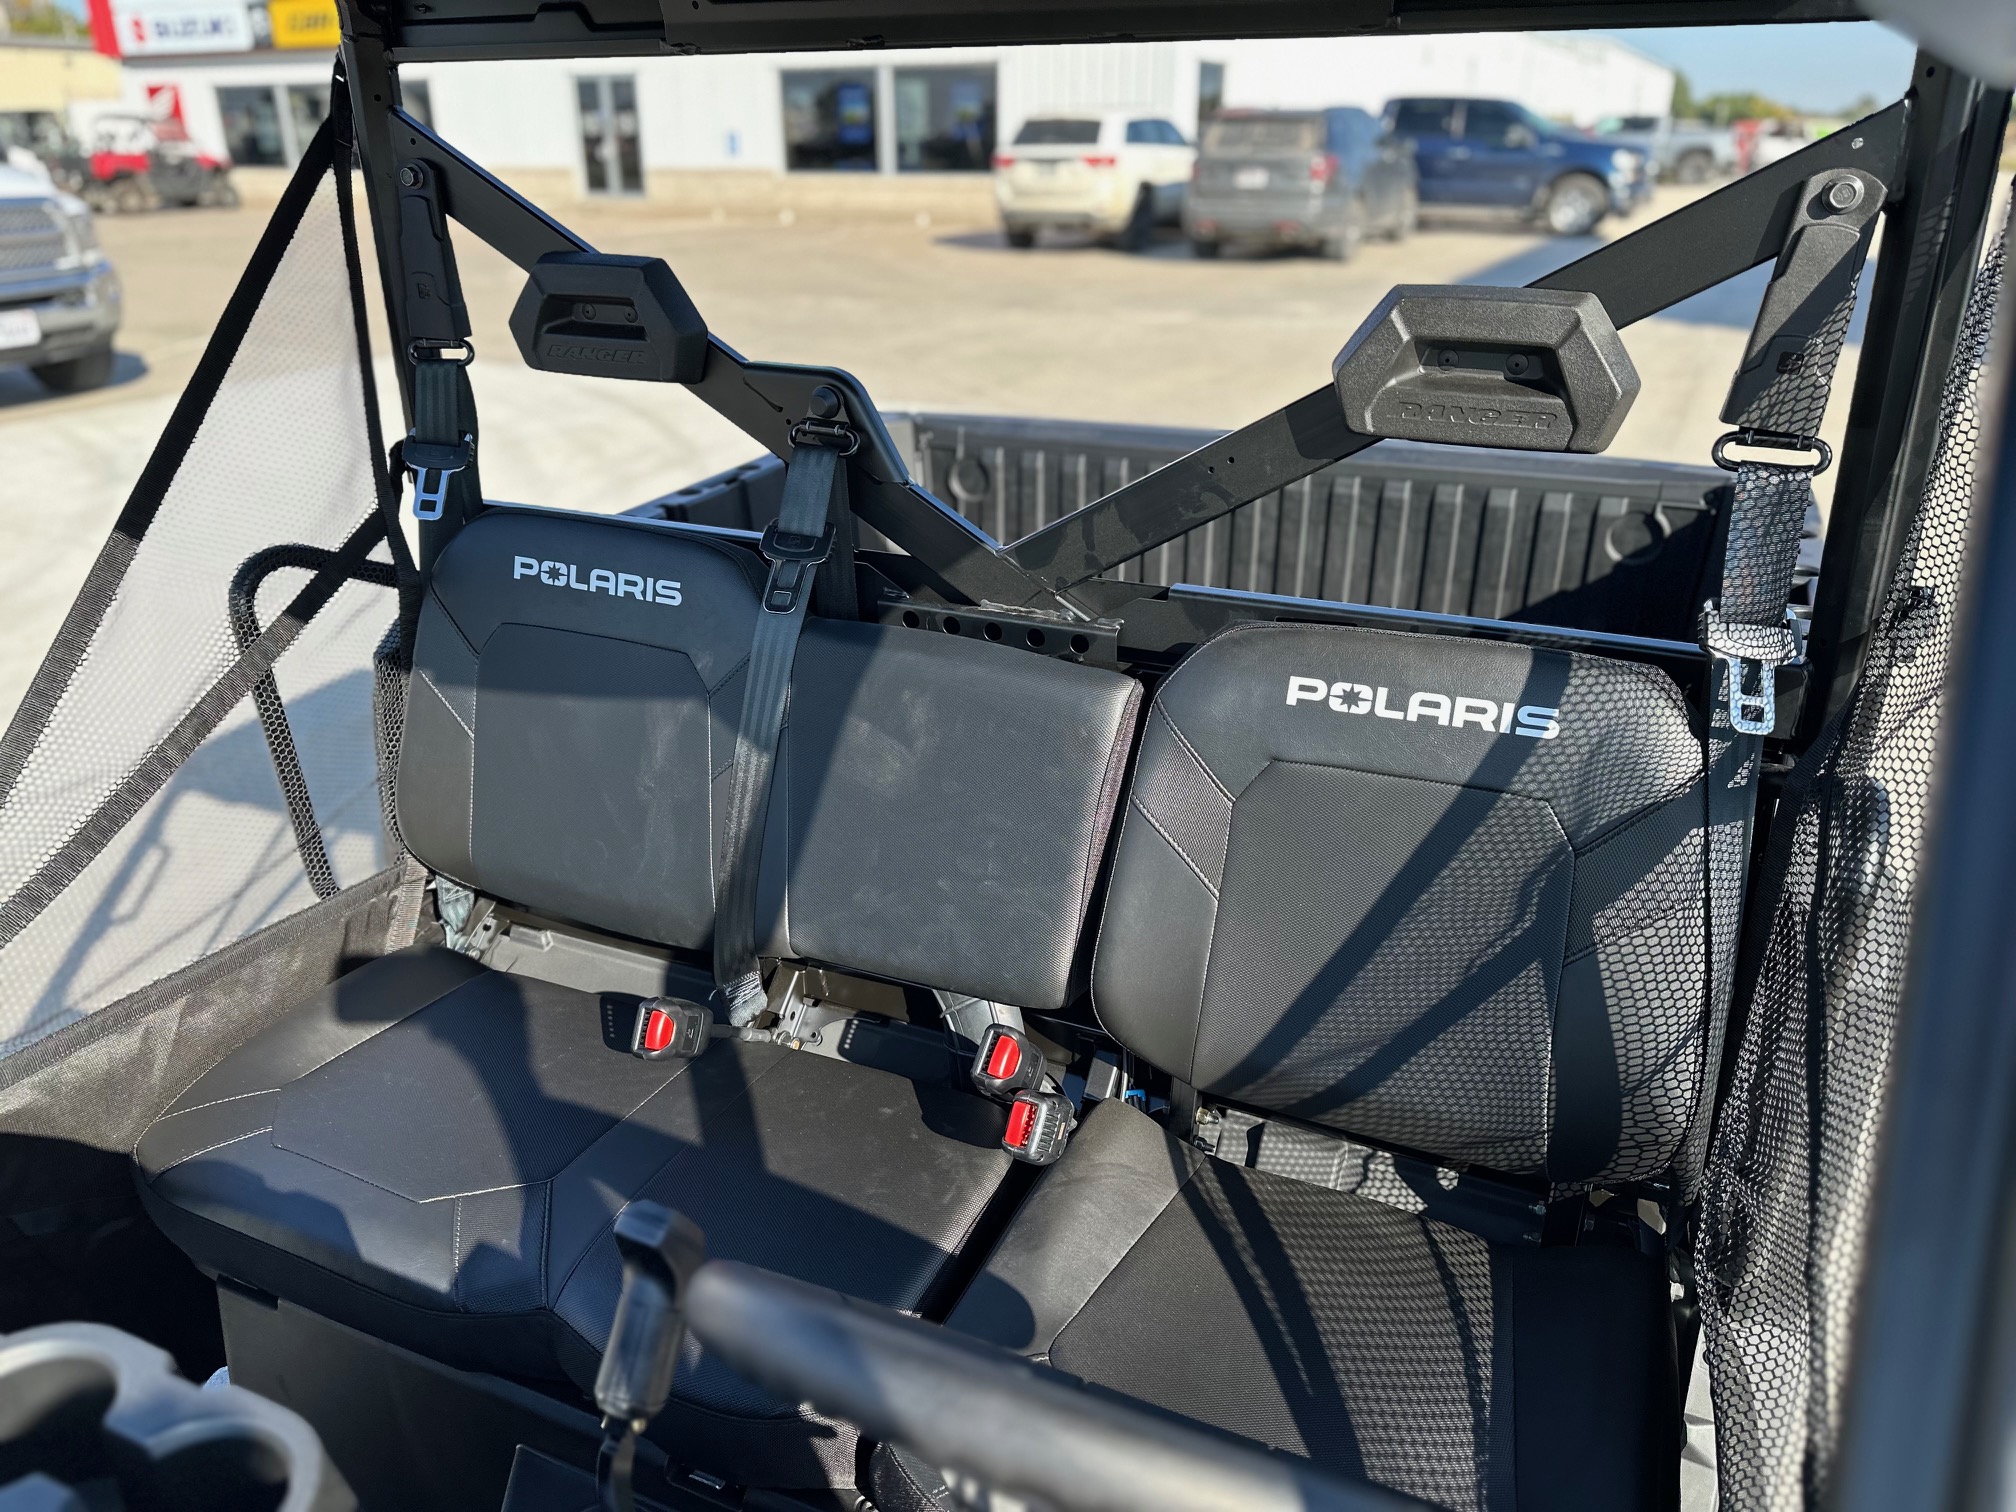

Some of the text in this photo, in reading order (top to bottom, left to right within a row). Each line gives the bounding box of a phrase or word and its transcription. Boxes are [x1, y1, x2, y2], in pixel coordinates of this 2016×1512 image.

[547, 344, 649, 365] RANGER
[1387, 401, 1558, 430] RANGER
[513, 555, 683, 607] POLARIS
[1285, 675, 1561, 740] POLARIS
